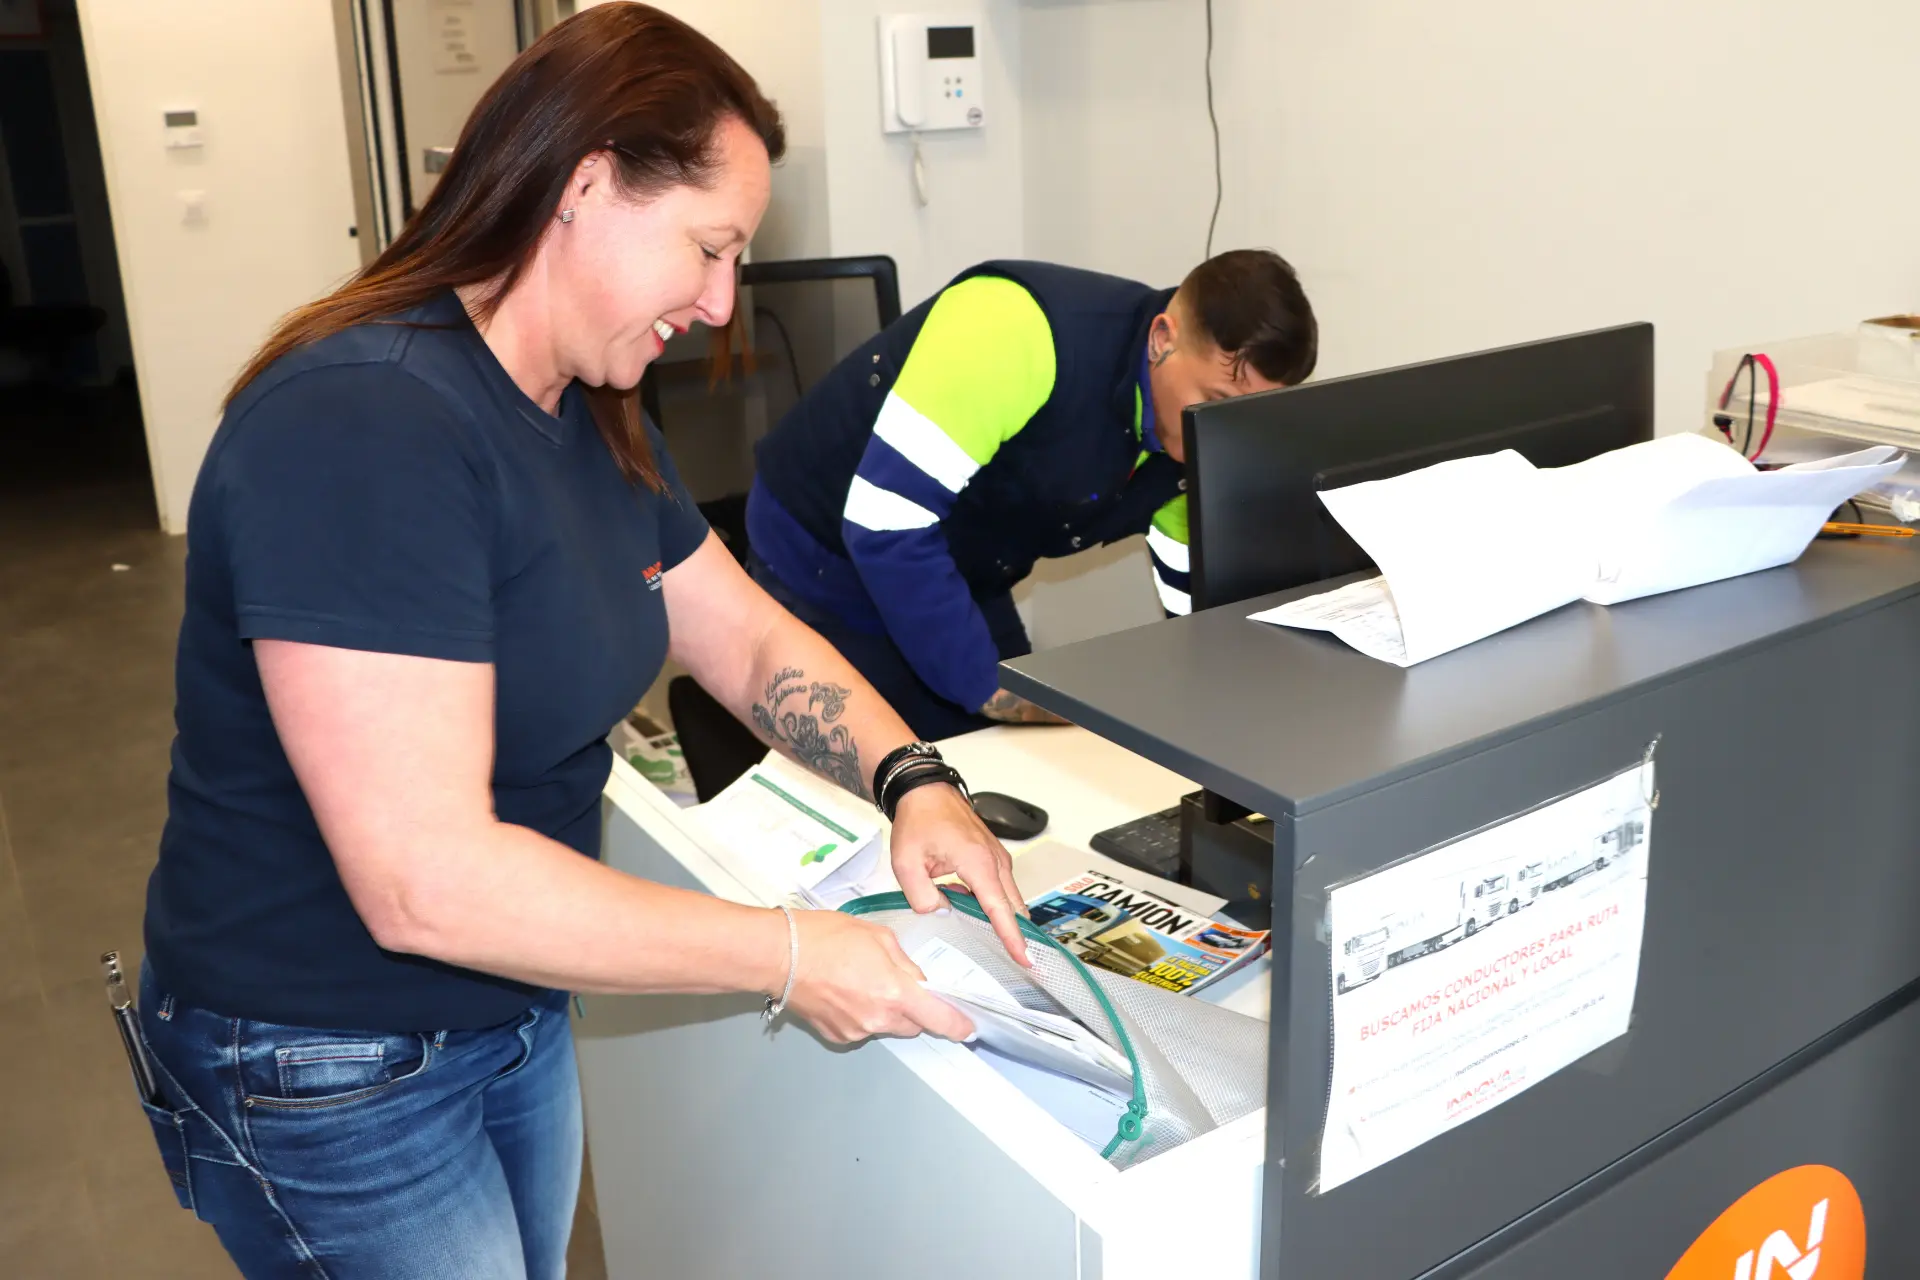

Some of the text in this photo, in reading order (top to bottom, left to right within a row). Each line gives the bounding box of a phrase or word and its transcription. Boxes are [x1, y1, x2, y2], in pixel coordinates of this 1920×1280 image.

[1064, 877, 1096, 893] SOLO
[1148, 961, 1200, 987] 100%
[1360, 989, 1442, 1041] BUSCAMOS
[1443, 937, 1546, 999] CONDUCTORES
[1548, 921, 1583, 947] PARA
[1587, 903, 1619, 929] RUTA
[1412, 1010, 1442, 1037] FIJA
[1446, 972, 1517, 1018] NACIONAL
[1521, 966, 1529, 980] Y
[1533, 945, 1574, 974] LOCAL
